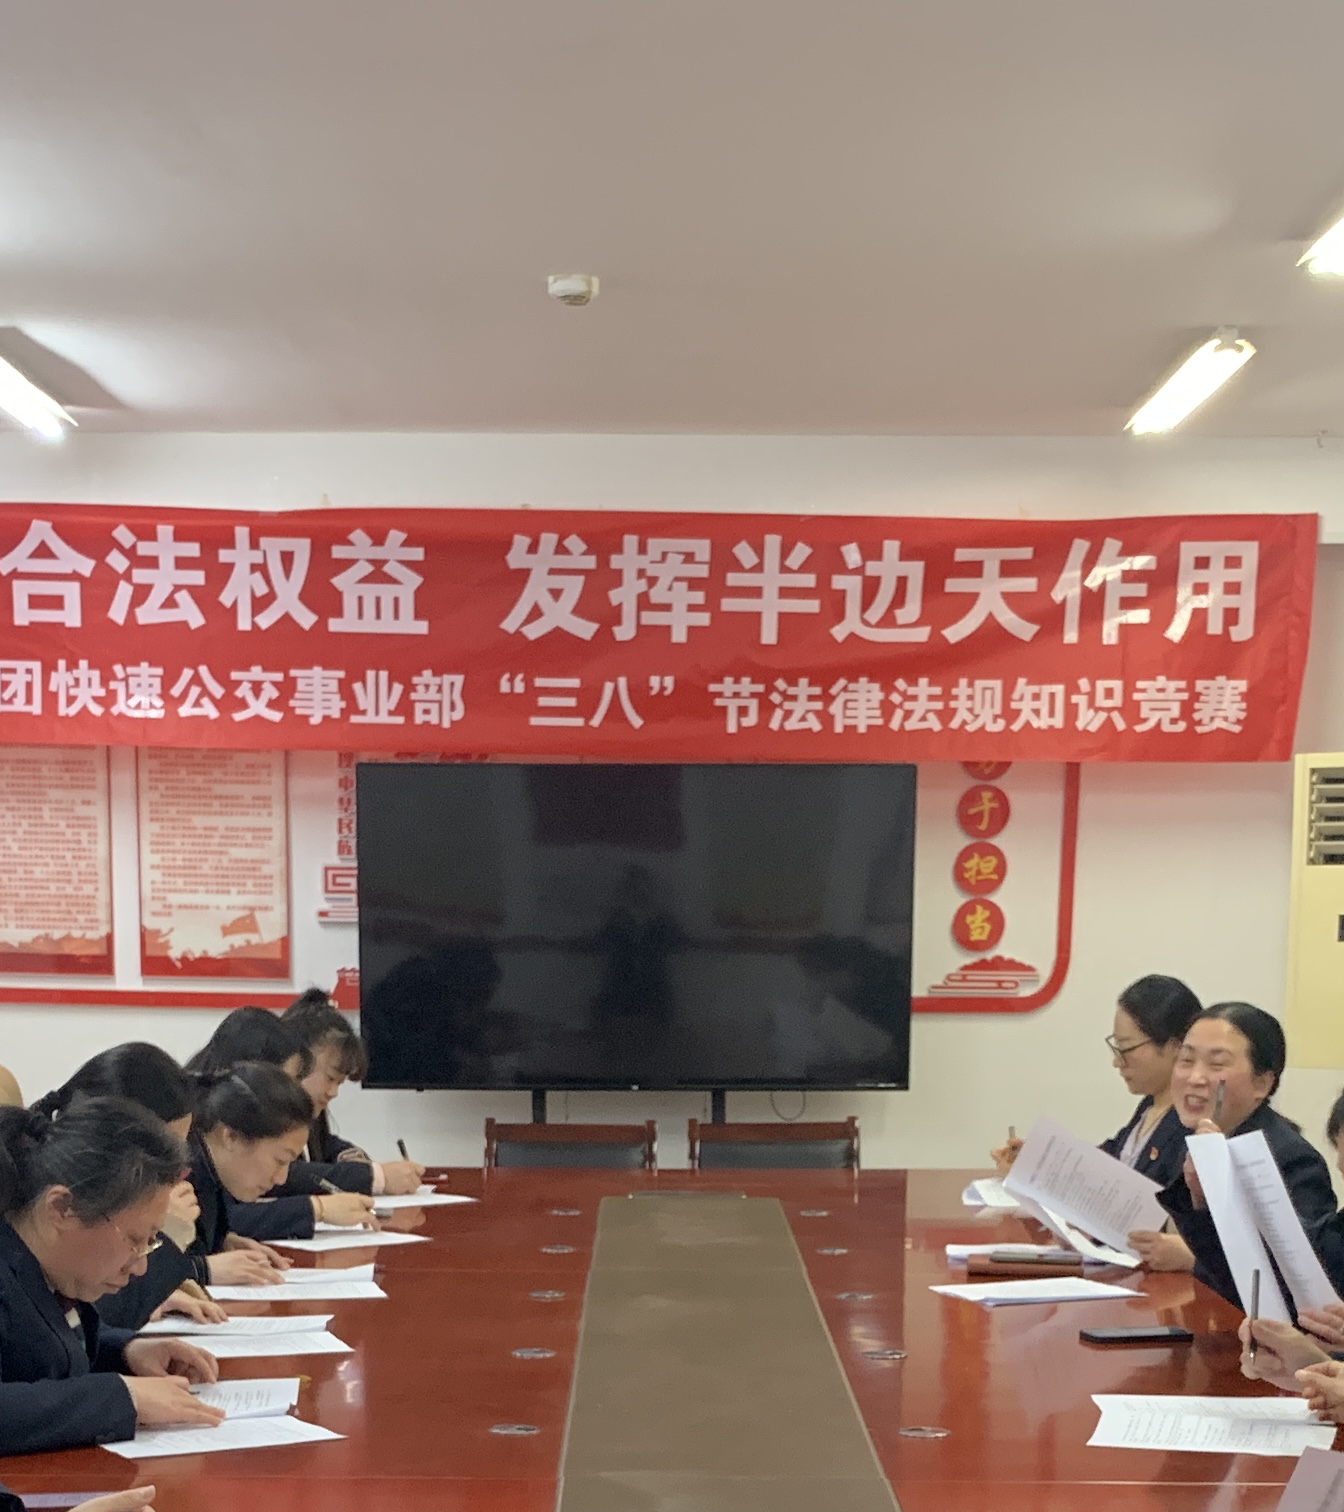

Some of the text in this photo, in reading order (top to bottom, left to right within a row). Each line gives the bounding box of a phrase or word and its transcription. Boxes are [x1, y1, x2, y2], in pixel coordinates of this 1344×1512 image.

[499, 532, 1260, 646] 发挥半边天作用
